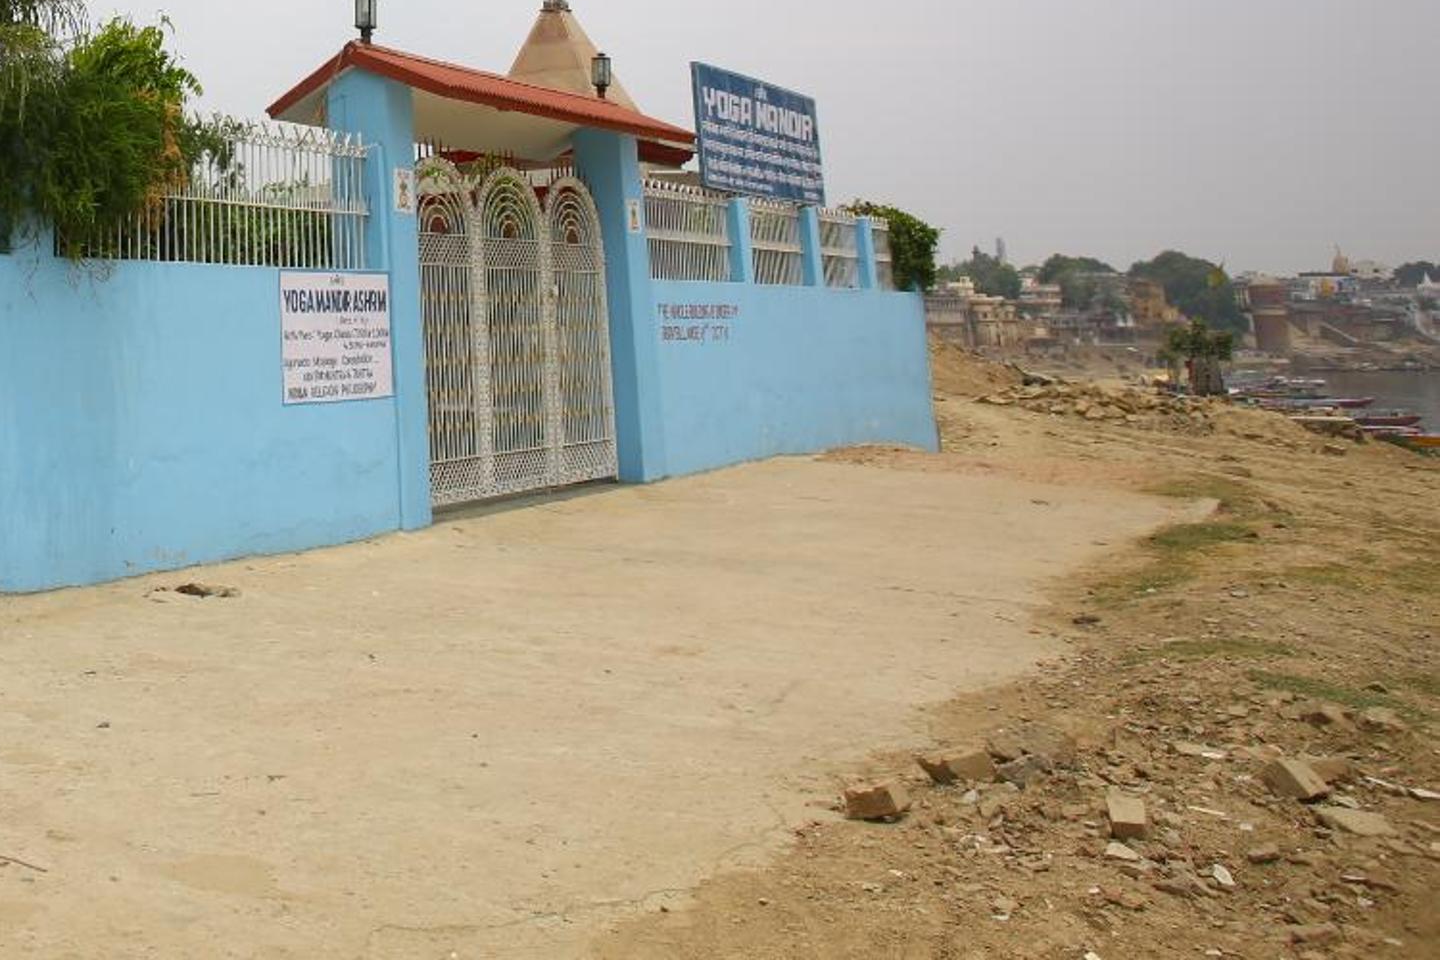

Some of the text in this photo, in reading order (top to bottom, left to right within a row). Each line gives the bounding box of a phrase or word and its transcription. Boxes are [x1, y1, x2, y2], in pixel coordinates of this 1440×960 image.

[702, 85, 752, 126] YOGA
[755, 100, 813, 142] MANDIR
[282, 289, 315, 313] YOGA
[316, 289, 352, 313] MANDIR
